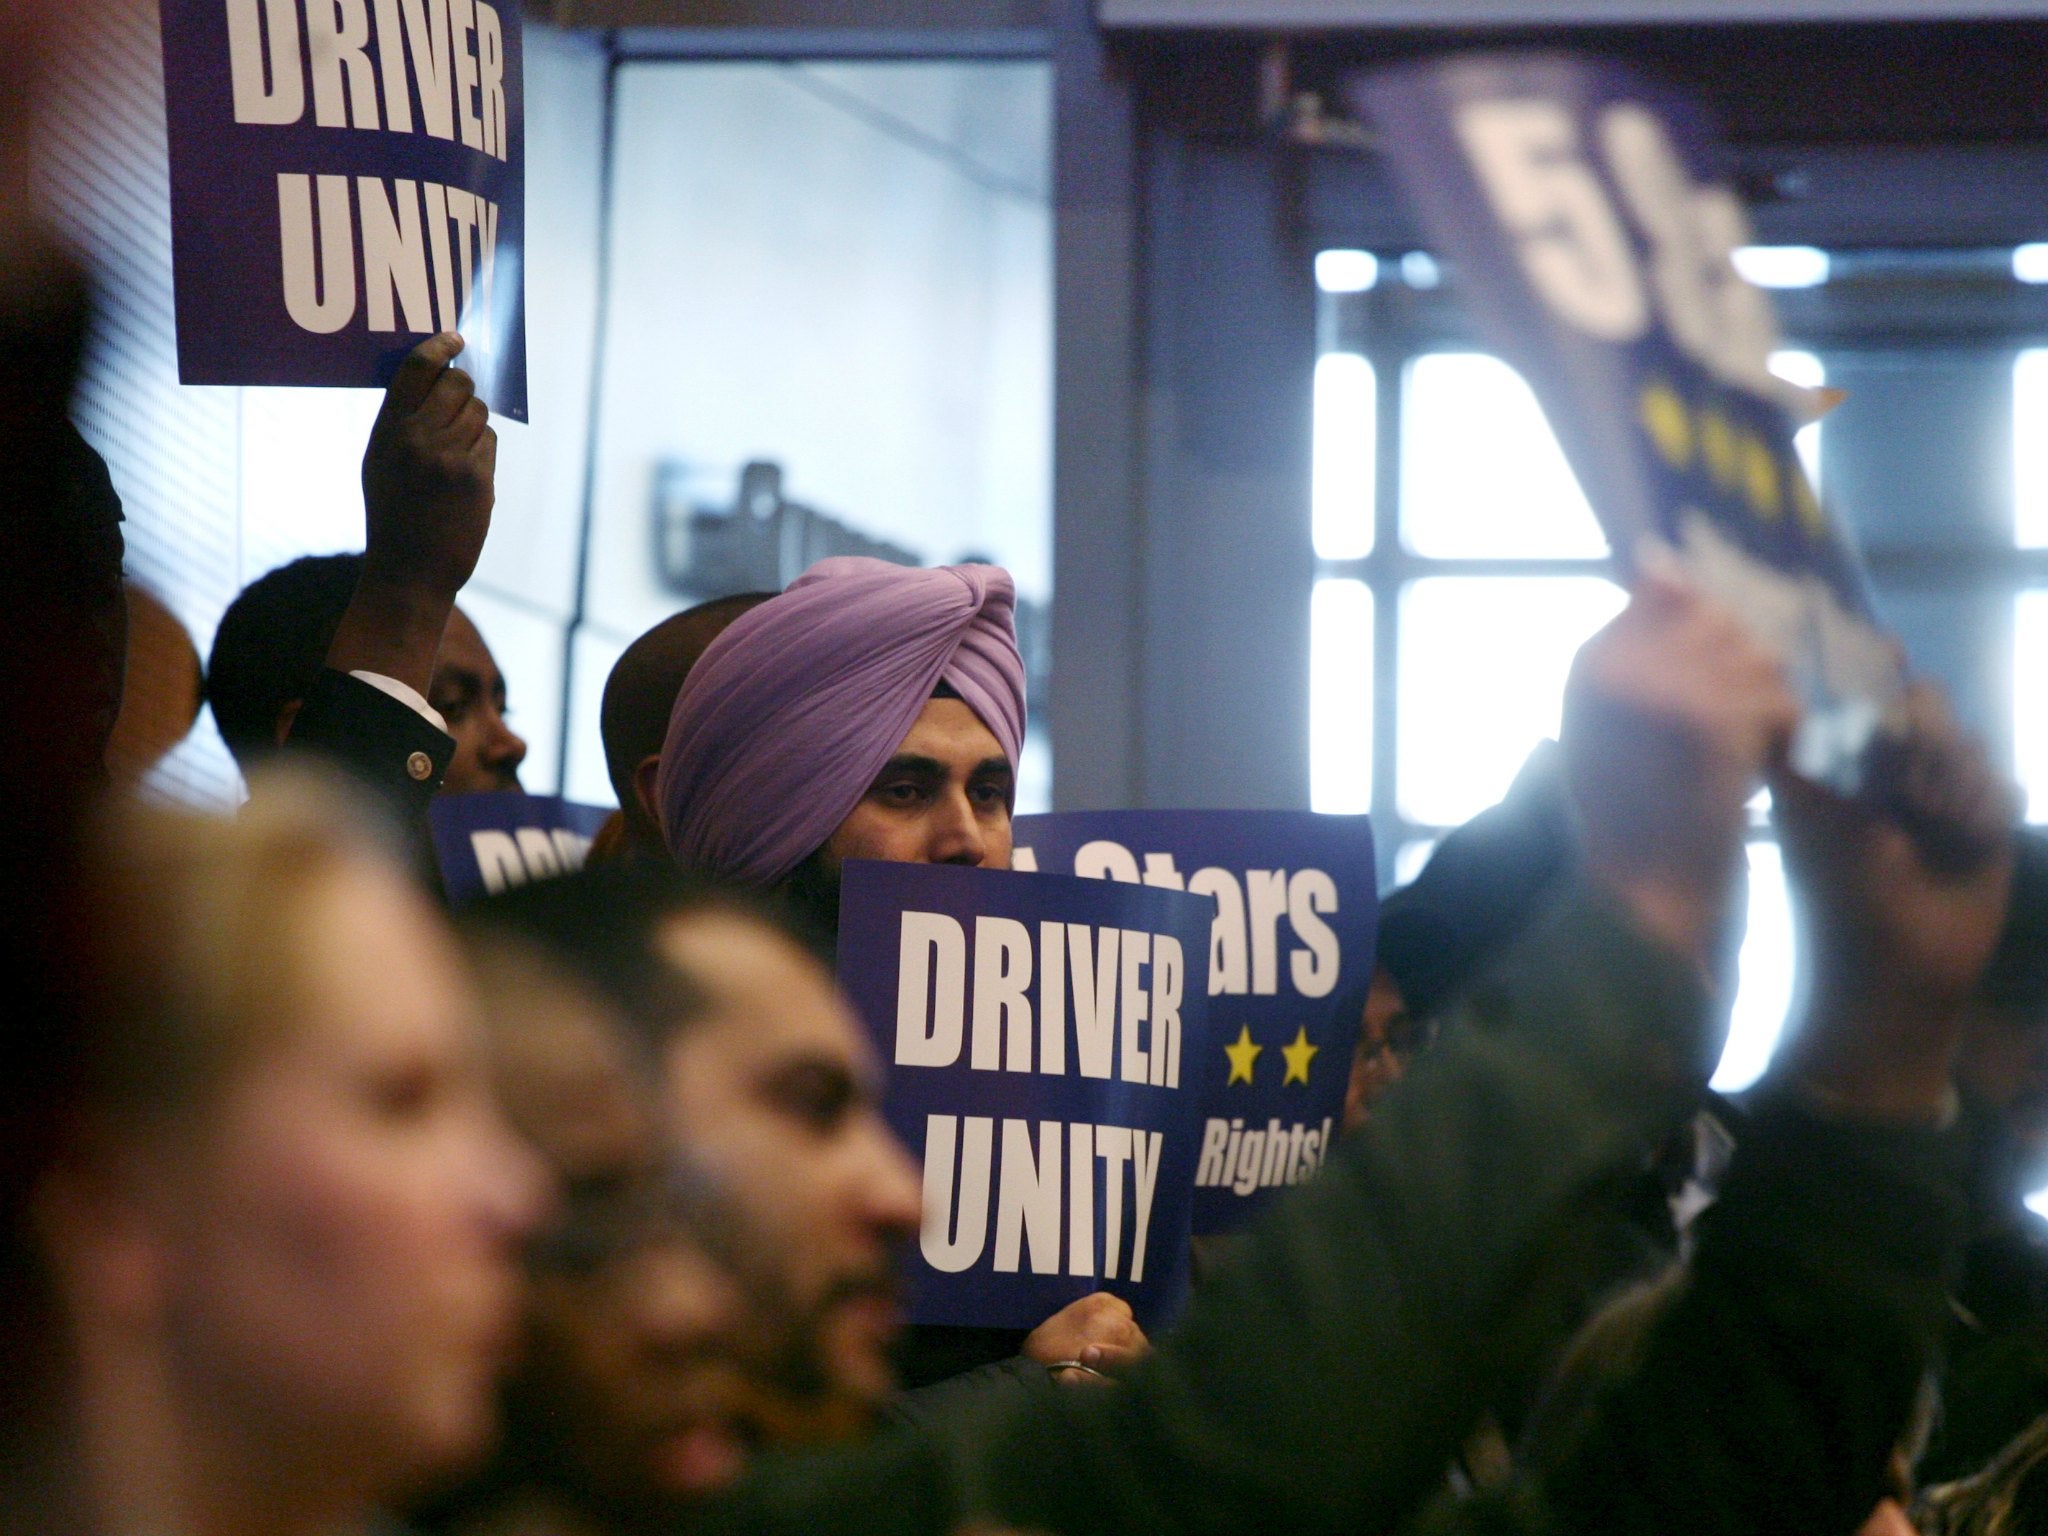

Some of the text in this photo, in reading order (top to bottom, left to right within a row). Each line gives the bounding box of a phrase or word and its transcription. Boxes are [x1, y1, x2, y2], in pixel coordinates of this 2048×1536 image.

[226, 0, 508, 162] DRIVER
[277, 173, 499, 353] UNITY
[895, 911, 1185, 1089] DRIVER
[1074, 840, 1340, 998] ars
[919, 1114, 1164, 1283] UNITY
[1195, 1116, 1333, 1197] Rights!
